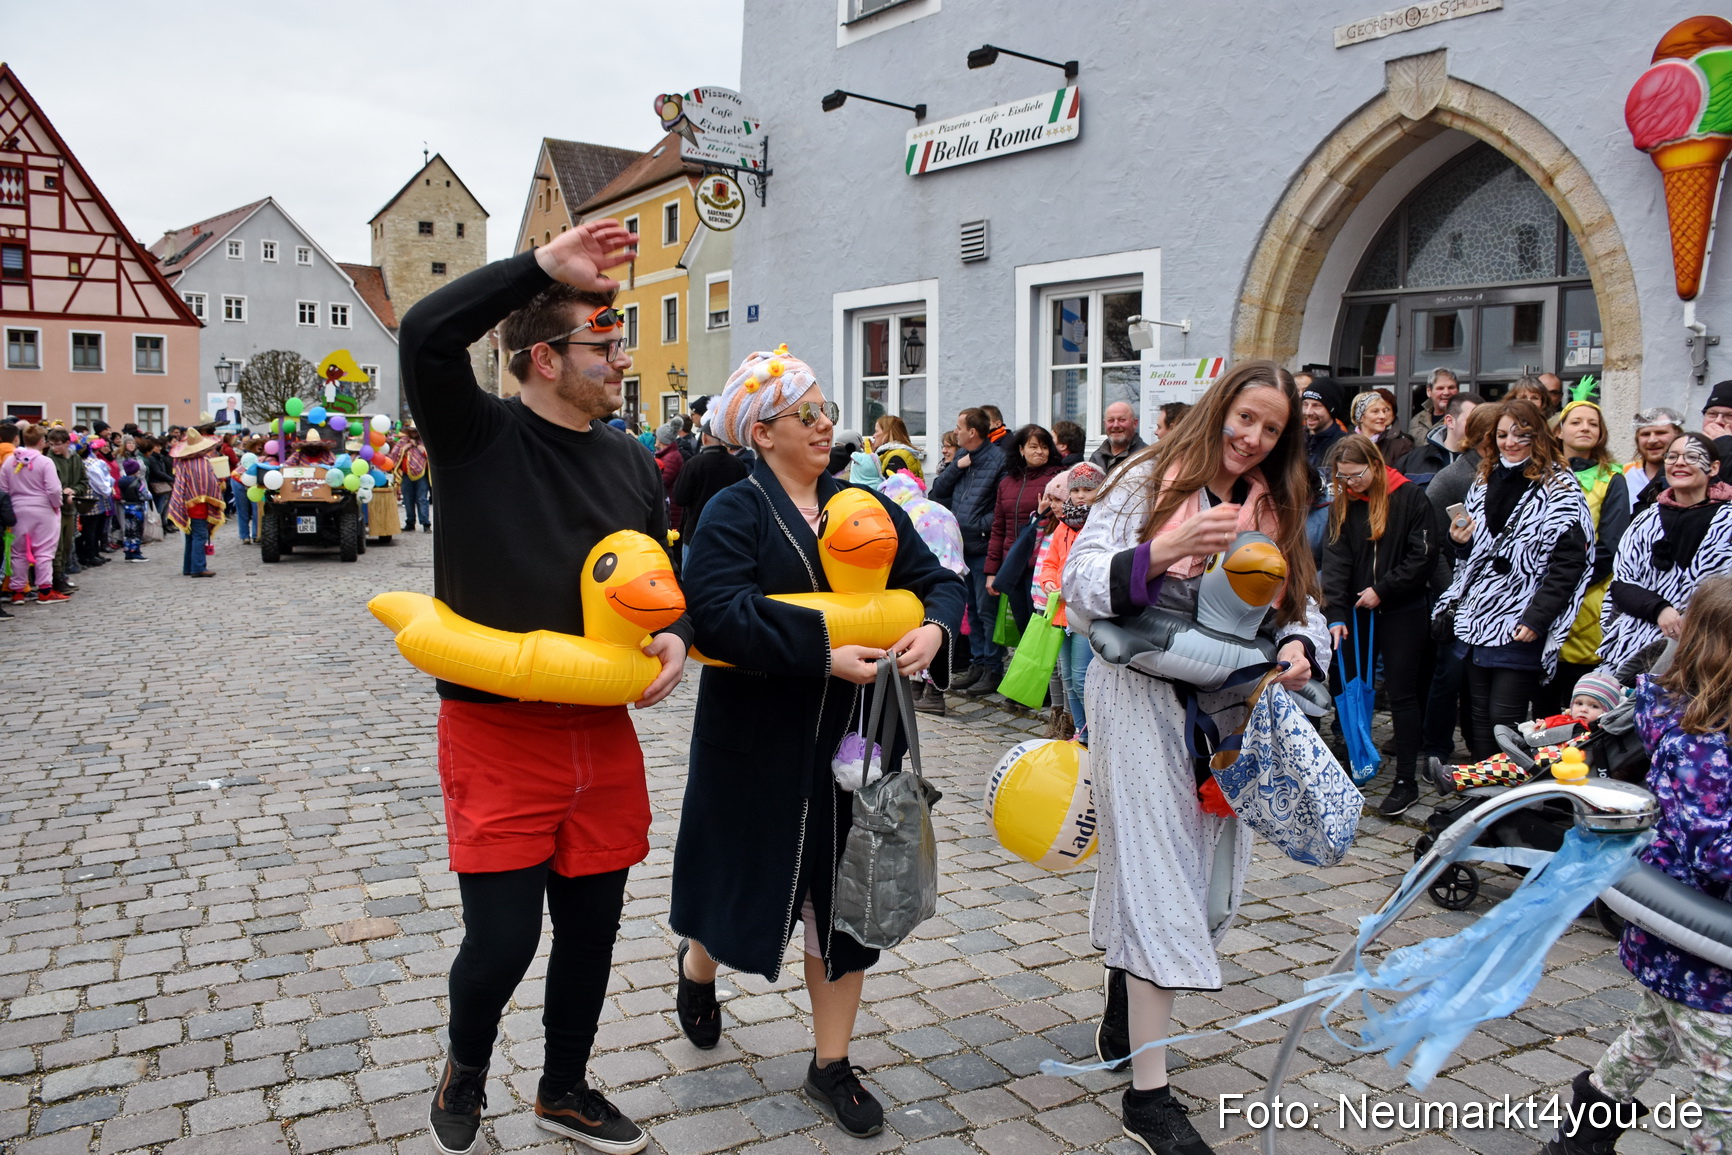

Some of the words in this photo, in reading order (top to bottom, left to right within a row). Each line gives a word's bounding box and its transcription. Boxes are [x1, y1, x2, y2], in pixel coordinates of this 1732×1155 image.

[701, 89, 742, 106] Pizzeria
[711, 106, 733, 119] Café
[937, 119, 971, 134] Pizzeria
[979, 111, 999, 125] Café
[1008, 100, 1043, 117] Eisdiele
[699, 117, 742, 134] Eisdiele
[707, 143, 736, 155] Bella
[931, 134, 979, 164] Bella
[985, 125, 1043, 152] Roma
[686, 147, 718, 159] Roma
[1150, 371, 1176, 379] Bella
[1159, 378, 1188, 386] Roma
[984, 745, 1027, 819] Ladival
